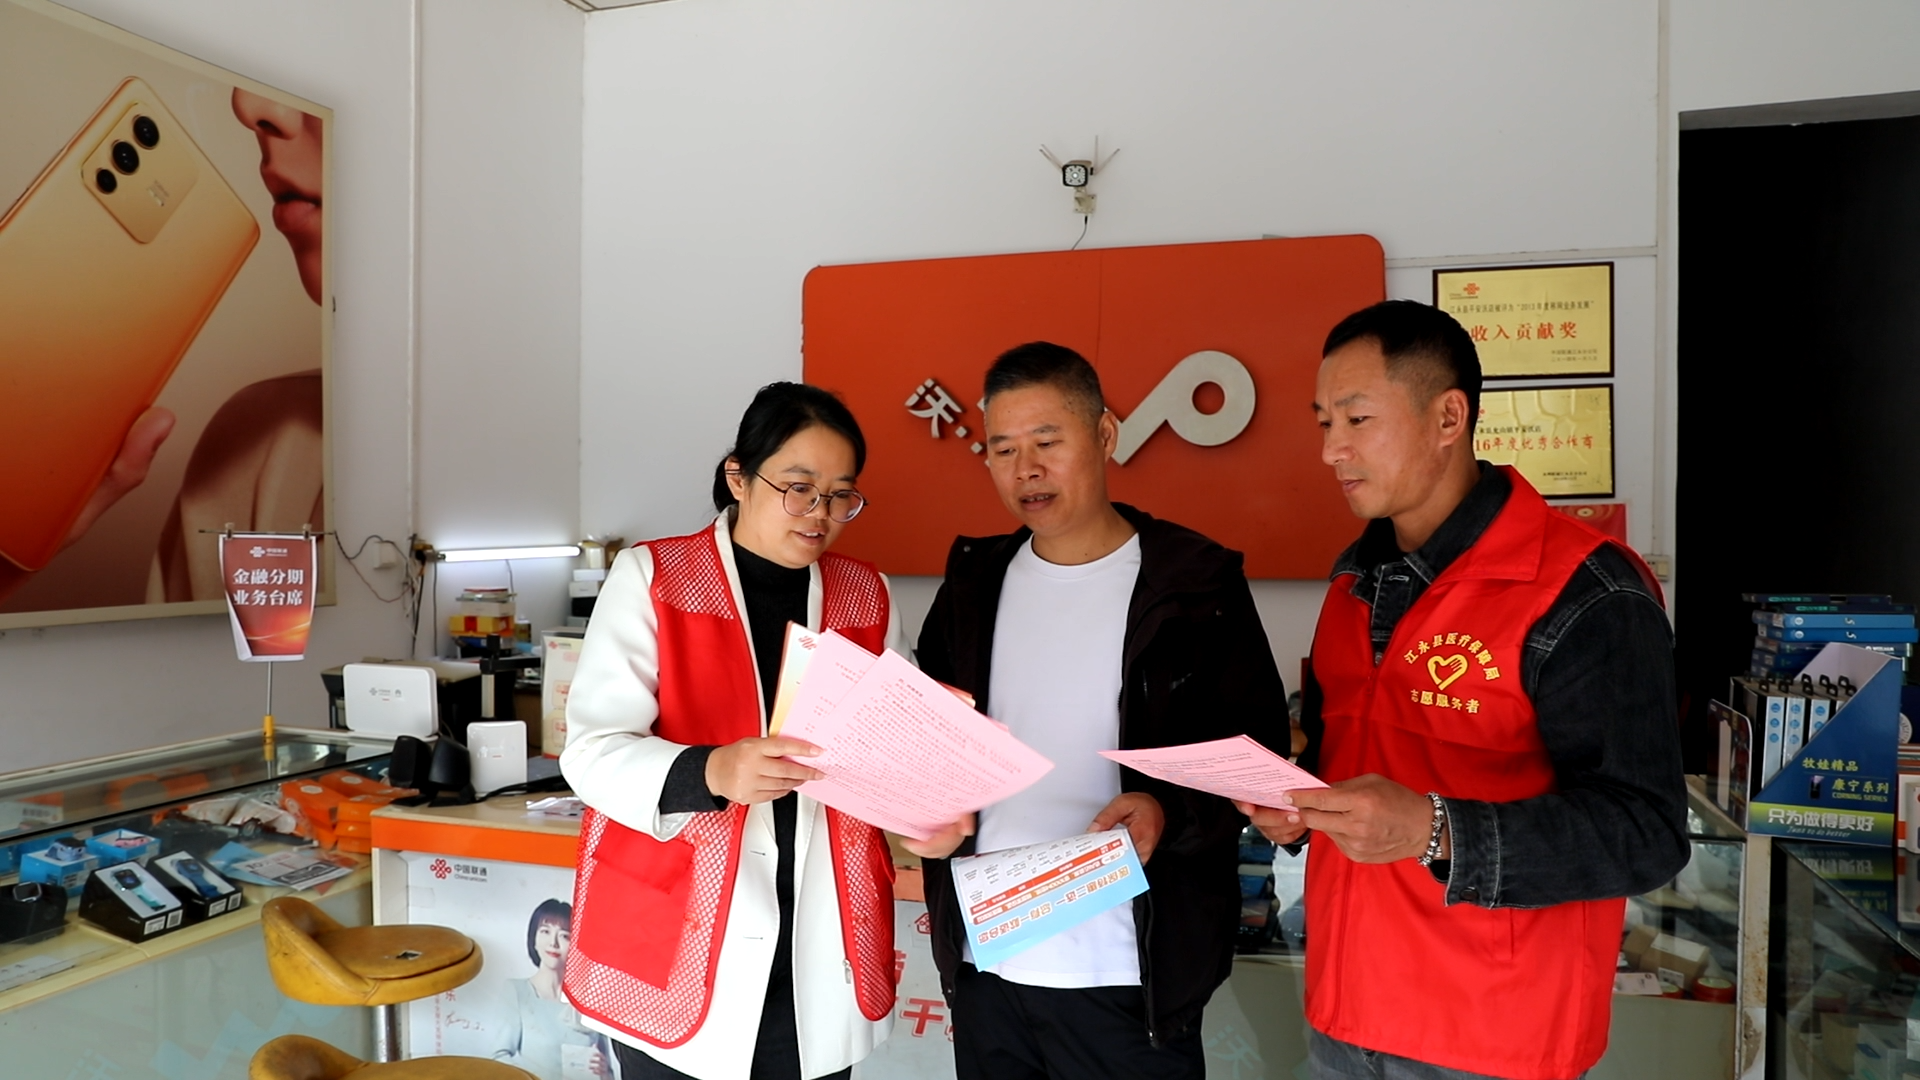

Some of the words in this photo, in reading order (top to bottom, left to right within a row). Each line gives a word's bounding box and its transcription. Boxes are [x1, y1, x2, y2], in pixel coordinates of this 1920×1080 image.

[1470, 321, 1577, 342] 收入贡献奖
[905, 378, 963, 438] 沃
[233, 568, 304, 585] 金融分期
[233, 589, 303, 606] 业务台席
[1410, 688, 1480, 714] 志愿服务者
[1832, 778, 1889, 794] 康宁系列
[1768, 808, 1875, 832] 只为做得更好
[454, 863, 487, 876] 中国联通
